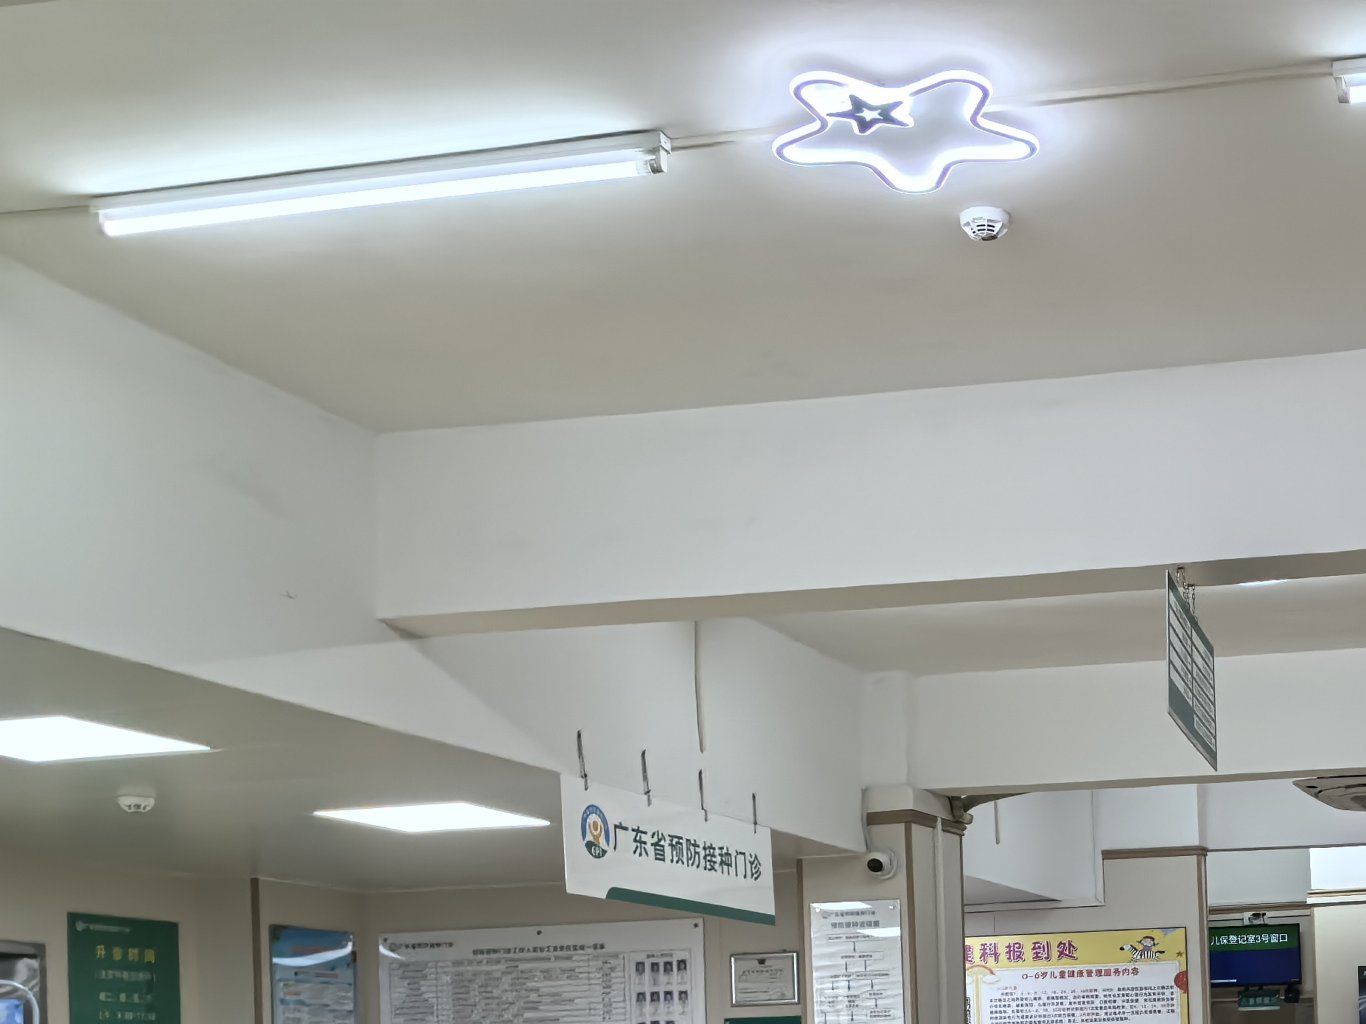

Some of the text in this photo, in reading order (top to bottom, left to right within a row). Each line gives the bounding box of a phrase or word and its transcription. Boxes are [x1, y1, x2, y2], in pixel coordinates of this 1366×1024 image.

[613, 821, 762, 882] 广东省预防接种门诊
[1210, 933, 1288, 946] 儿保登记室3号窗口
